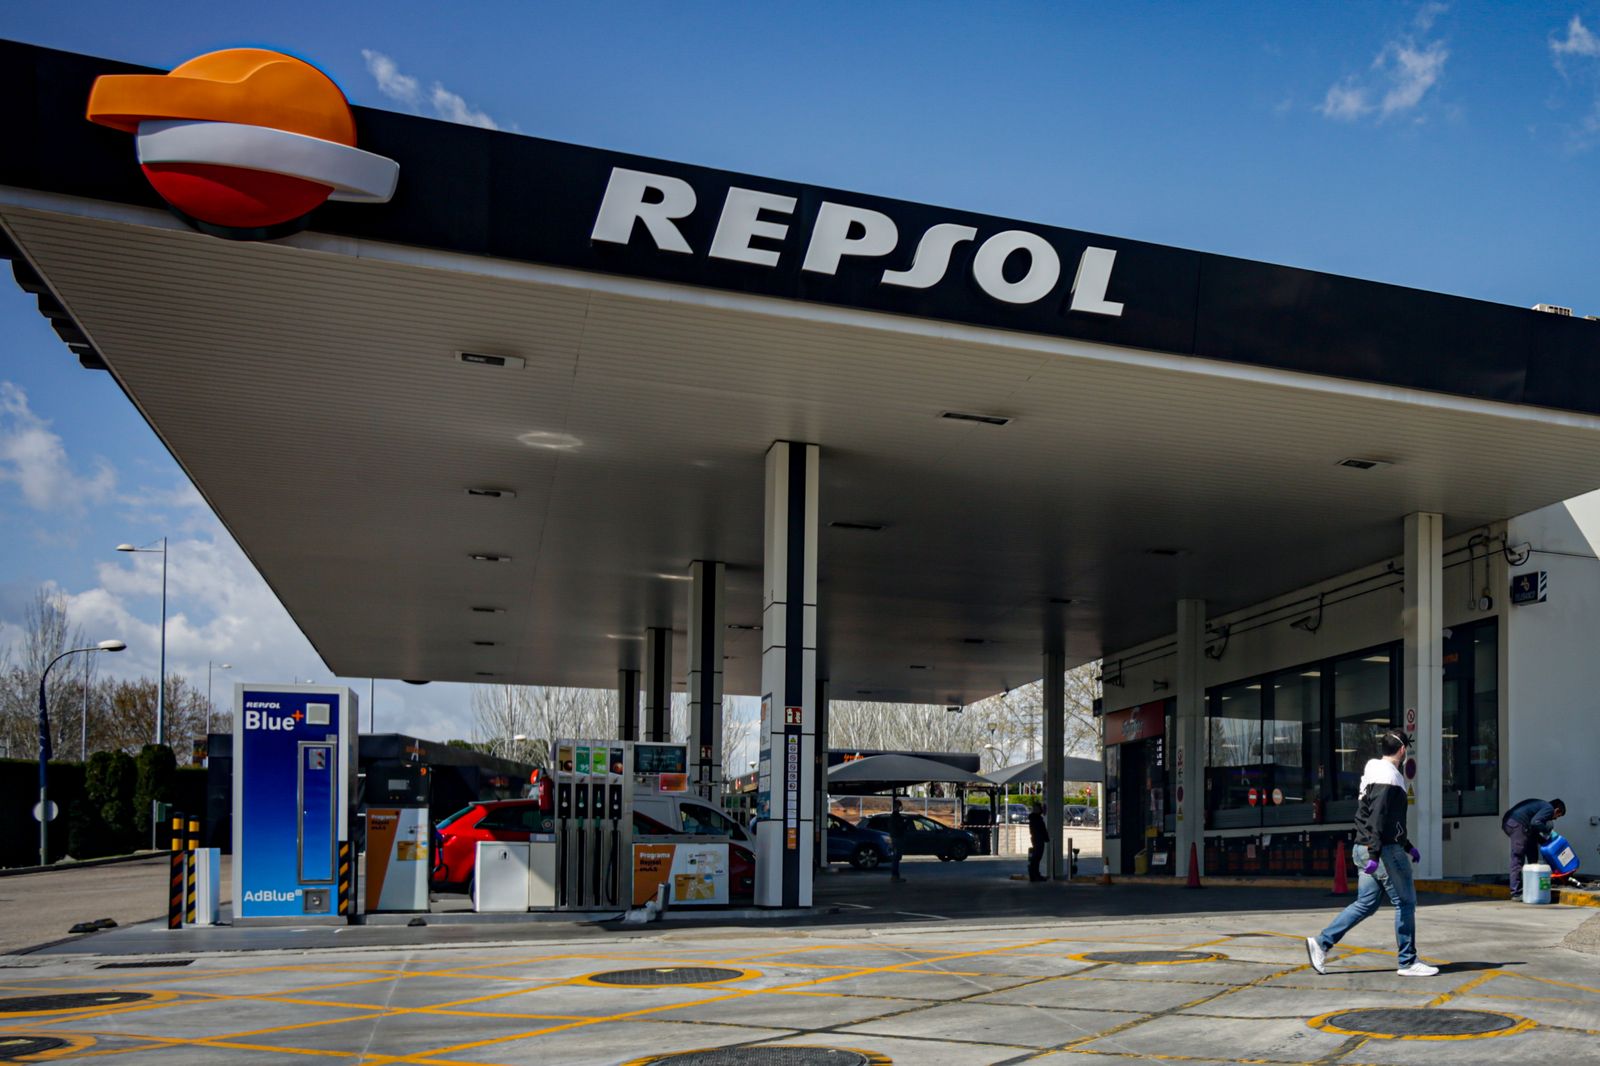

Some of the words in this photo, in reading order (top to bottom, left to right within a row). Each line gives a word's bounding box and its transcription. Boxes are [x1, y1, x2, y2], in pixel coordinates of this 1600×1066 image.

[590, 166, 1125, 318] REPSOL
[246, 701, 281, 709] REPSOL
[639, 852, 670, 861] Programa
